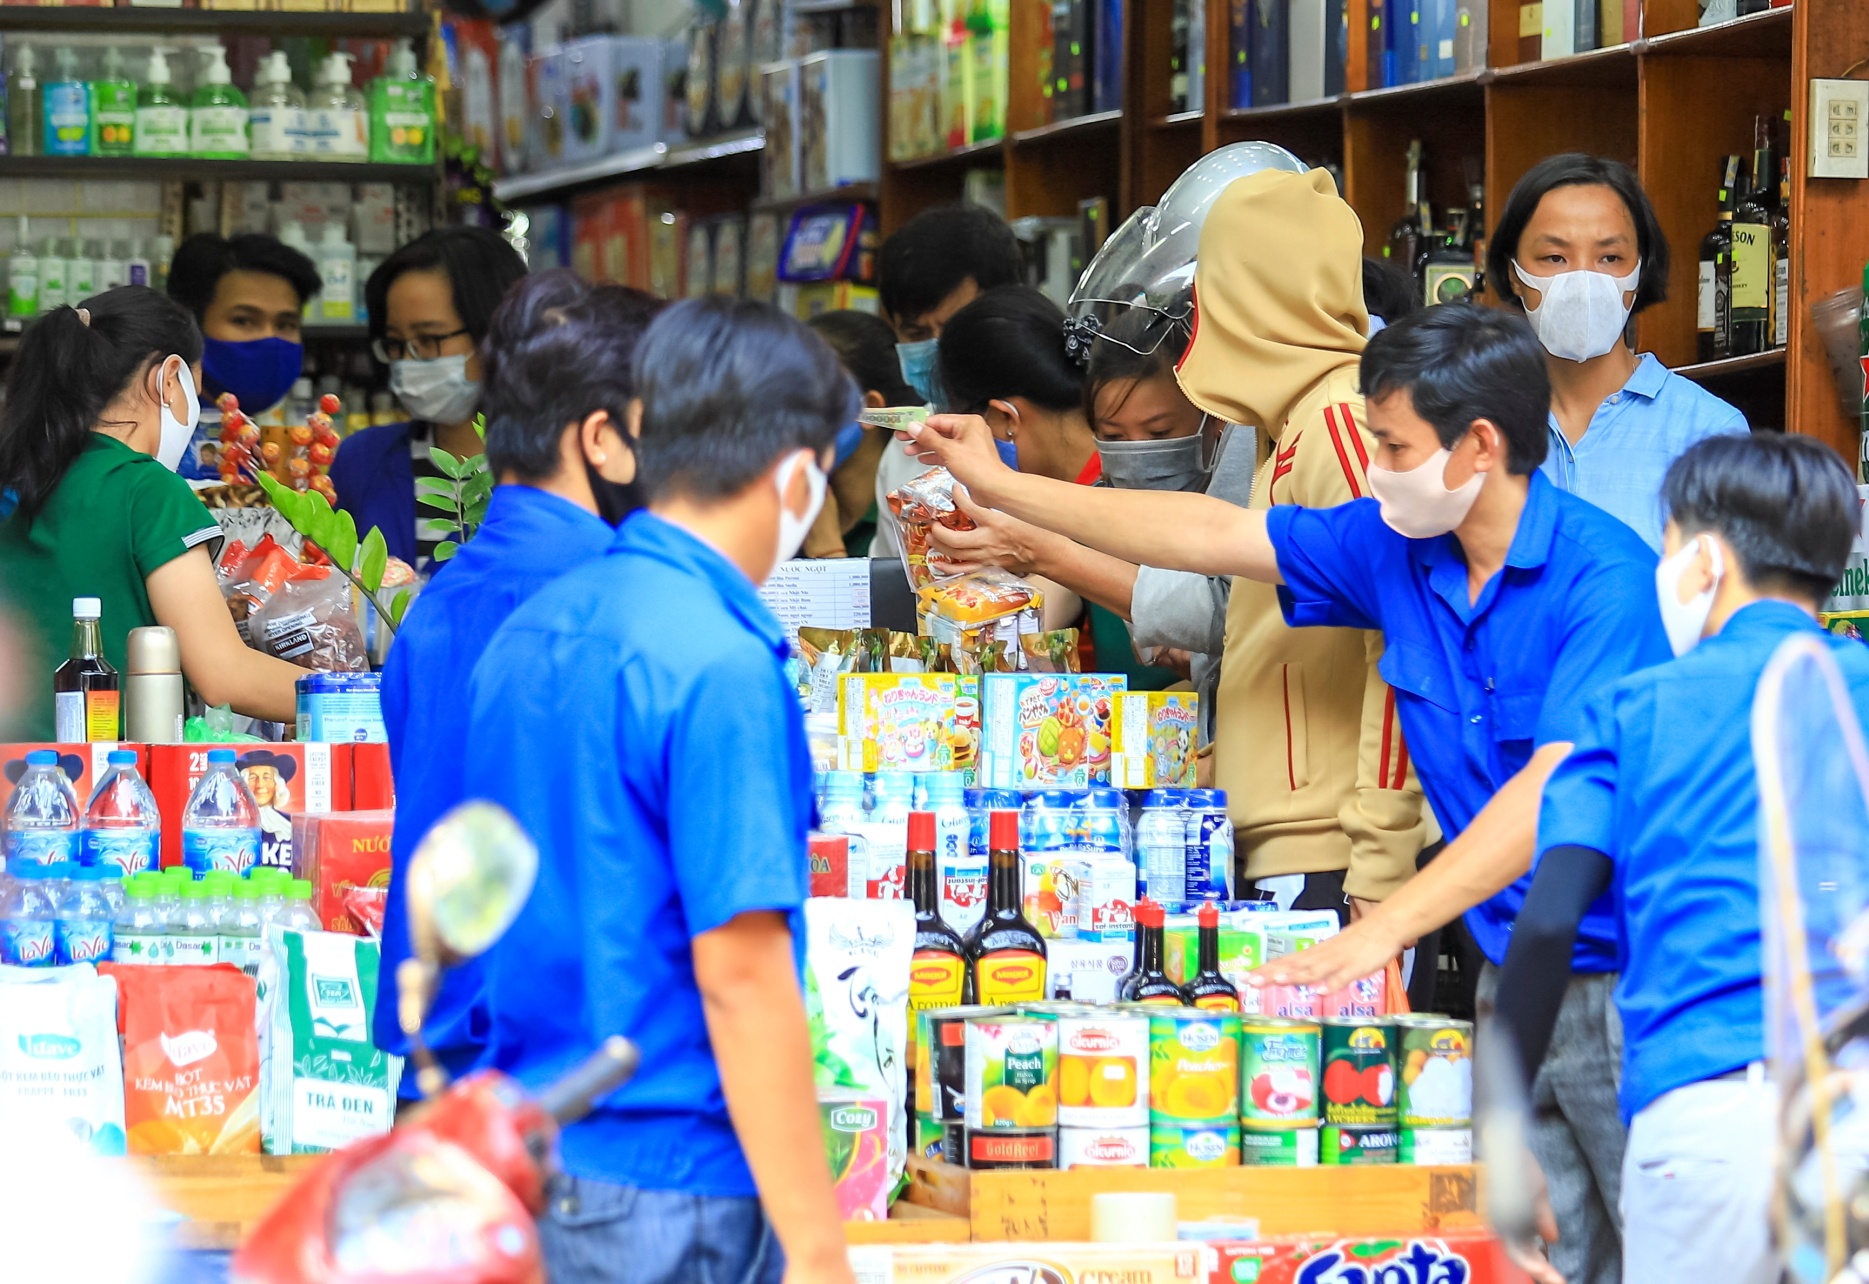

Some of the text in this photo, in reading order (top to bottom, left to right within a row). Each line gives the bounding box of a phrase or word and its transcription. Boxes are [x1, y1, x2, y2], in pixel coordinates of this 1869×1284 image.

[275, 634, 308, 651] KIRKLAND
[189, 751, 200, 773] 2
[913, 970, 948, 983] Maggi
[995, 970, 1029, 983] Maggi
[1278, 1001, 1314, 1017] alsa
[1339, 1001, 1376, 1017] alsa
[1007, 1056, 1042, 1071] Peach
[164, 1095, 226, 1118] MT35
[836, 1111, 872, 1127] Cozy
